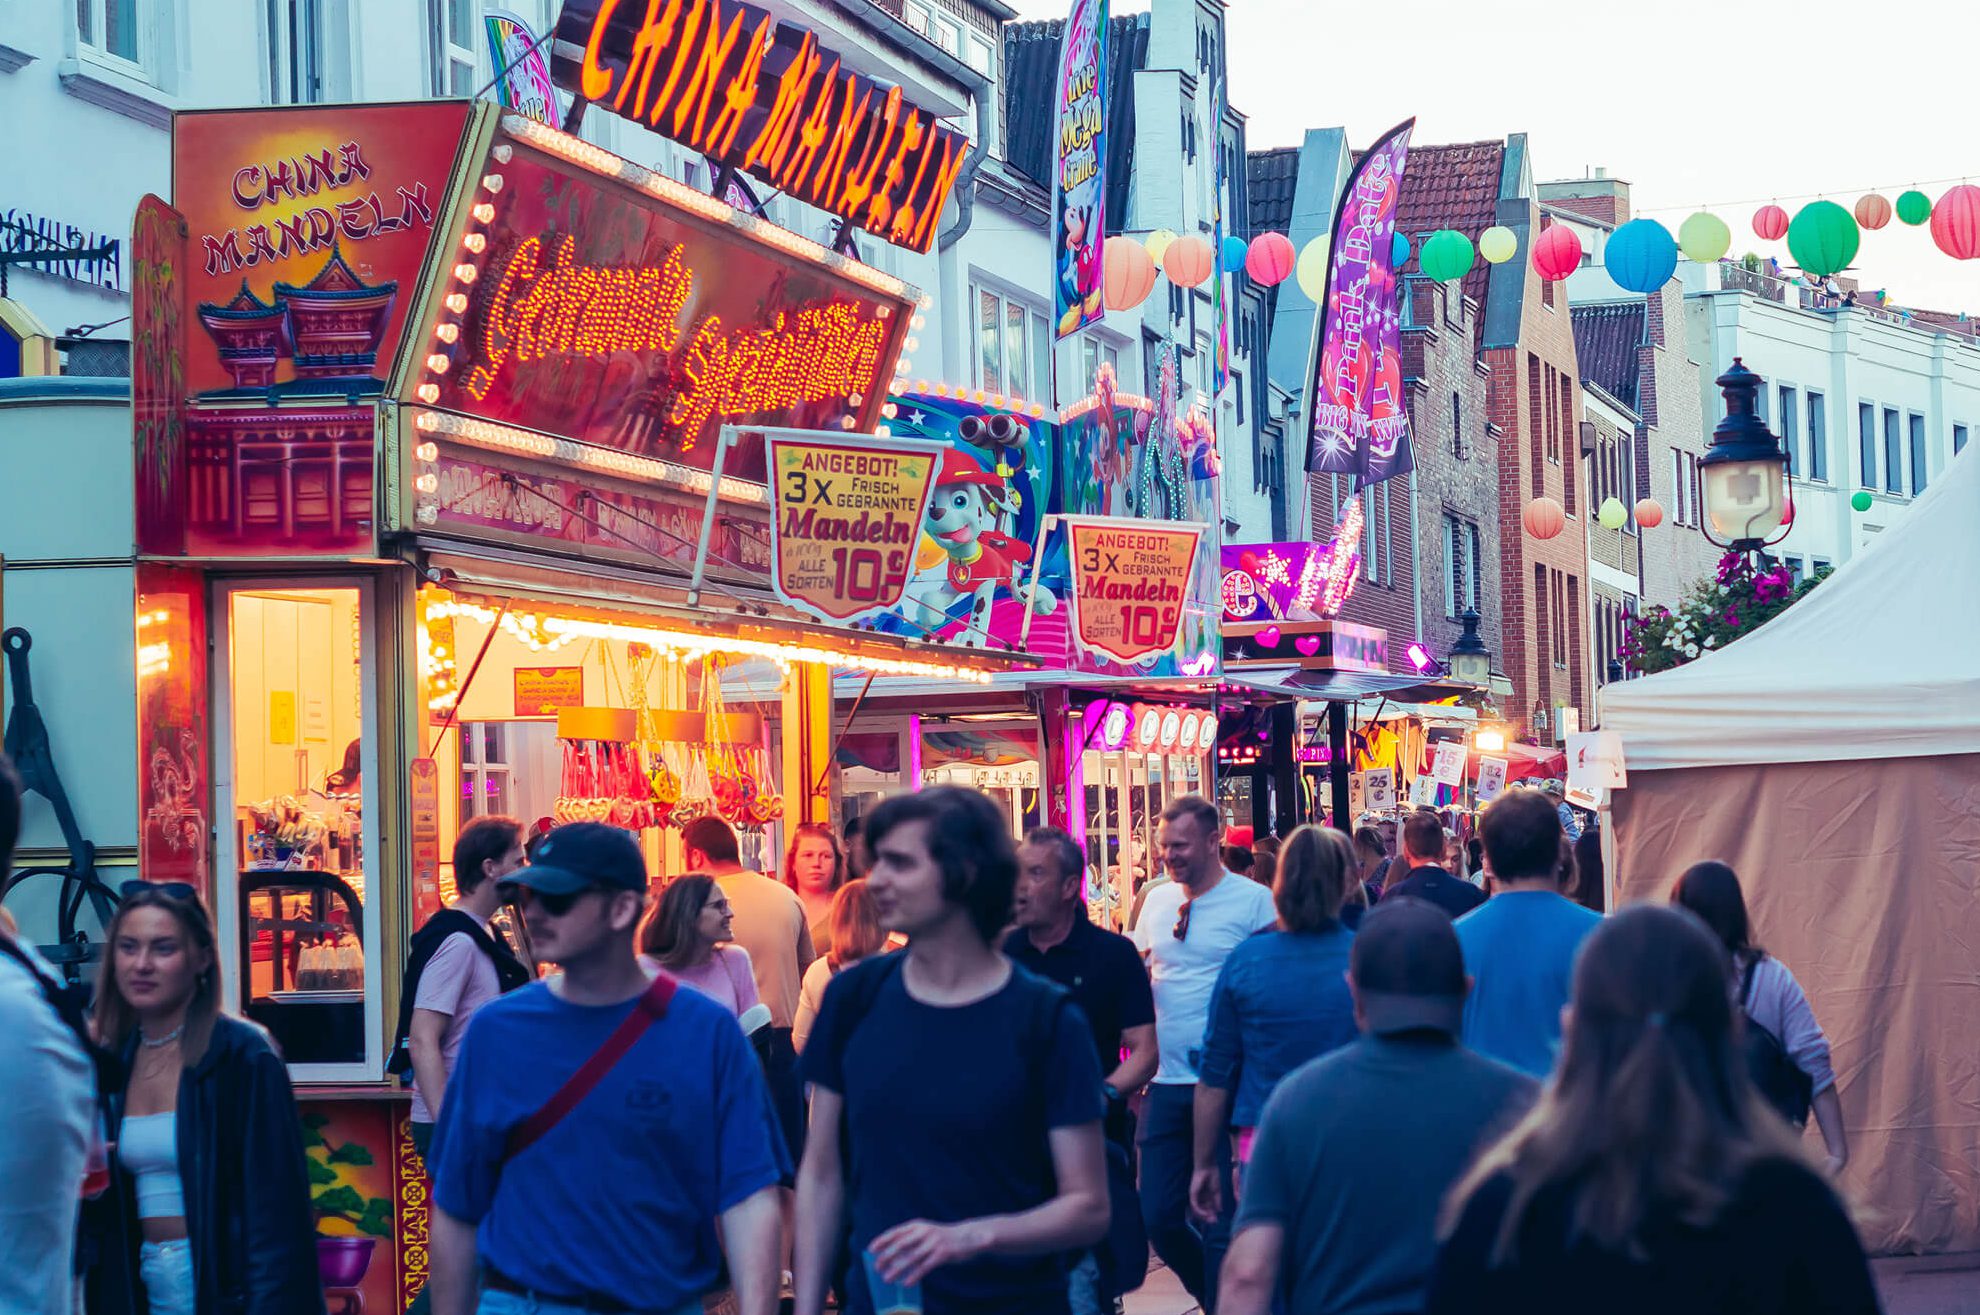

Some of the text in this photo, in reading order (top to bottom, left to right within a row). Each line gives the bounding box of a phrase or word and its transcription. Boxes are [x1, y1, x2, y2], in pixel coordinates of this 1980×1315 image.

[581, 0, 772, 161] CHINA
[1060, 95, 1104, 159] Mega
[231, 139, 371, 210] CHINA
[1063, 150, 1098, 193] Crane
[201, 180, 432, 277] MANDELN
[1334, 152, 1393, 400] Pink Date
[1315, 402, 1349, 432] BIG
[801, 451, 898, 478] ANGEBOT!
[784, 471, 807, 503] 3
[851, 477, 900, 494] FRISCH
[836, 493, 916, 512] GEBRANNTE
[781, 507, 911, 545] Mandeln
[1095, 534, 1169, 551] ANGEBOT!
[798, 559, 826, 572] ALLE
[1083, 548, 1100, 572] 3
[1133, 551, 1171, 564] FRISCH
[787, 573, 833, 590] SORTEN
[1122, 564, 1184, 577] GEBRANNTE
[1081, 575, 1180, 602] Mandeln
[1085, 625, 1122, 639] SORTEN
[1094, 614, 1116, 626] ALLE
[1368, 774, 1388, 789] 25
